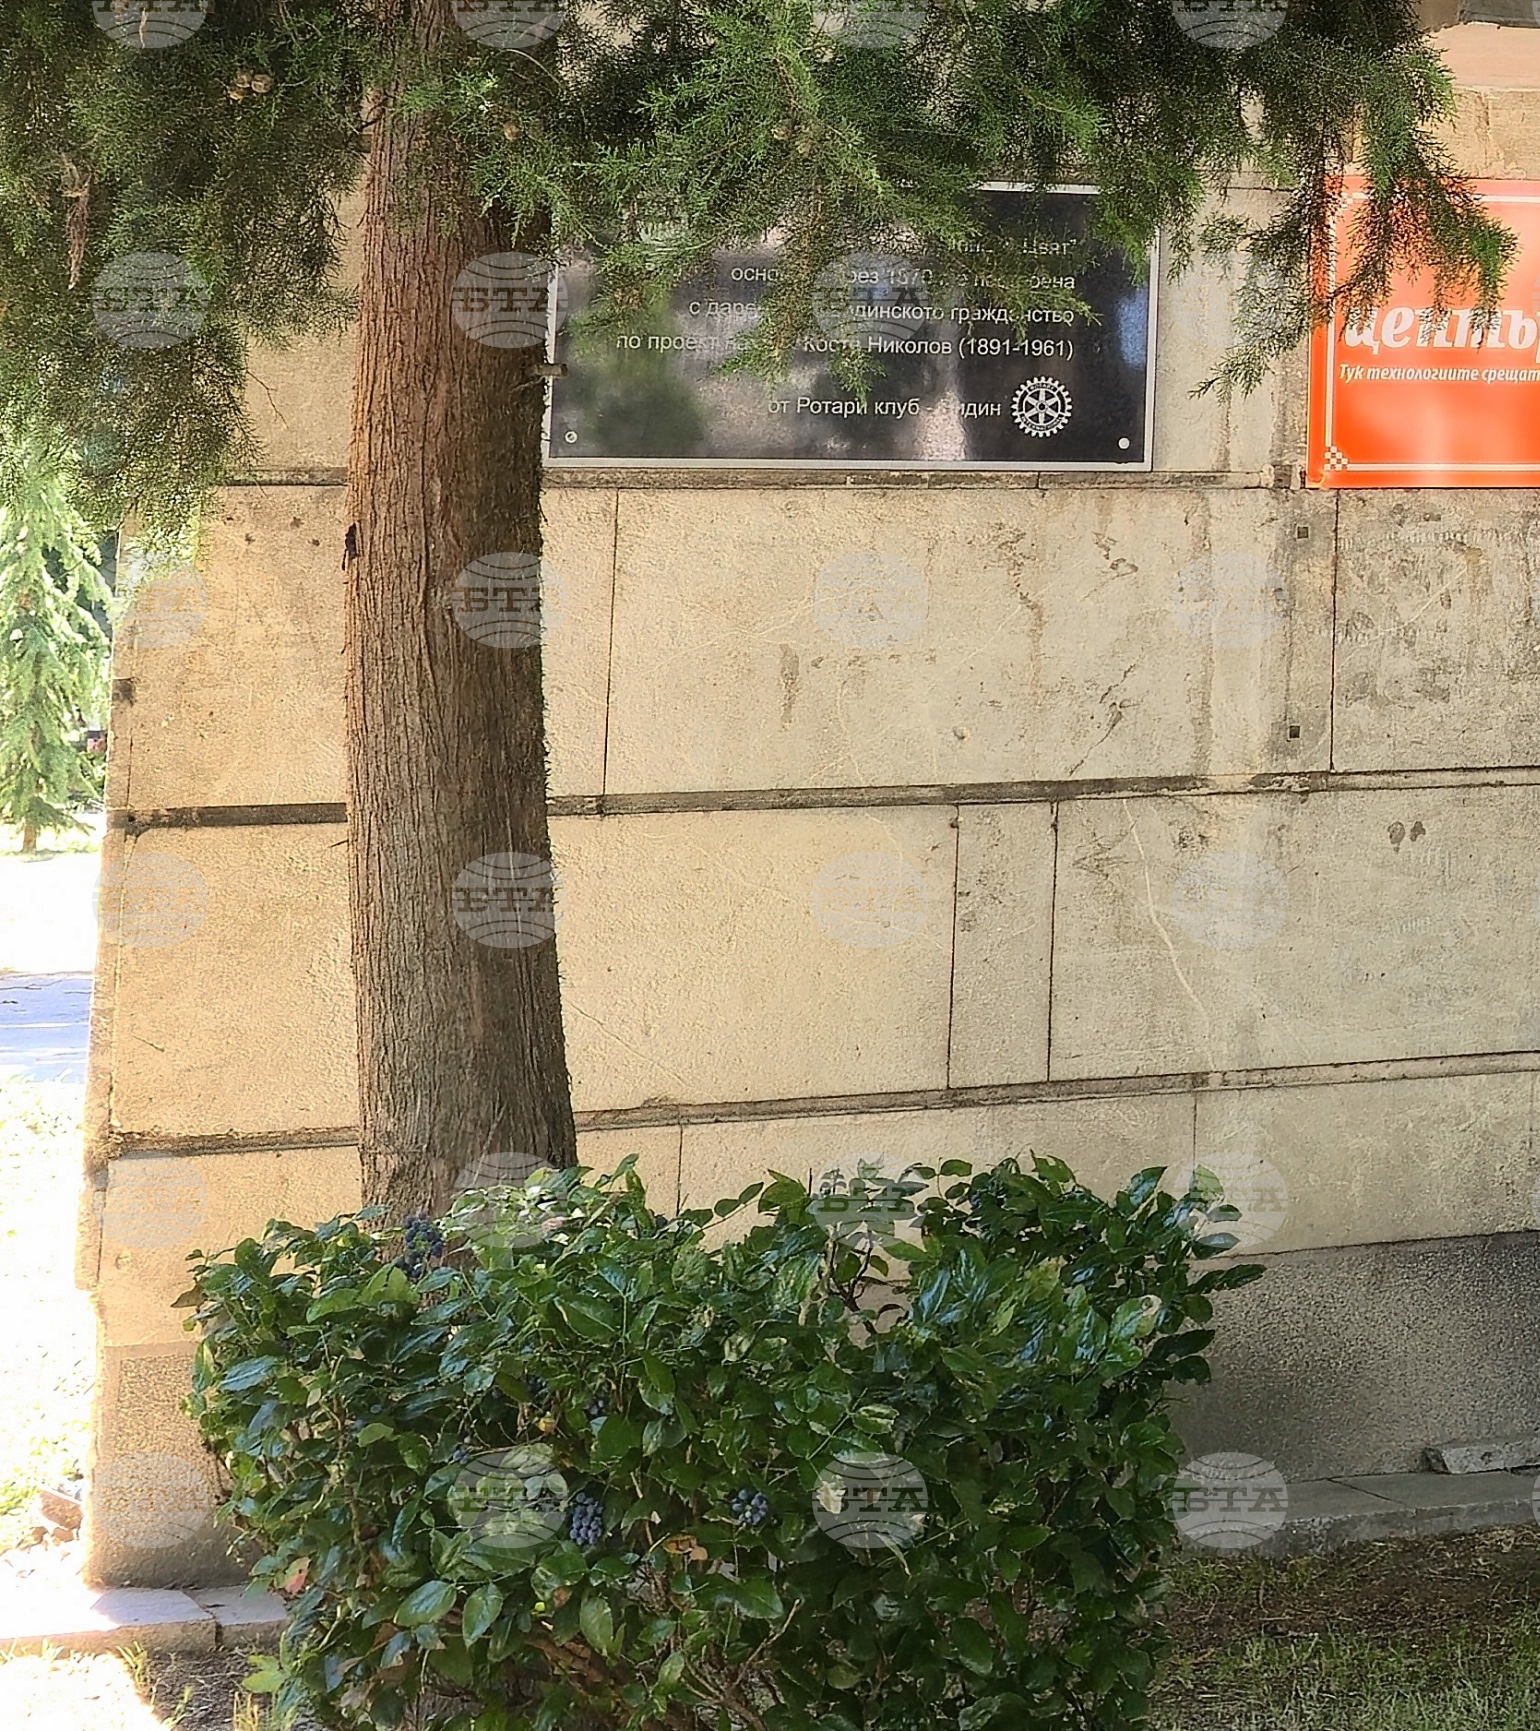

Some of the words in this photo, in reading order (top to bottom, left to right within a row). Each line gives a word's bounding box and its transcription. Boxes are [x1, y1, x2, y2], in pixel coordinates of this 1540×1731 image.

[868, 336, 952, 354] Николов
[958, 337, 1074, 360] (1891-1961)
[1339, 363, 1364, 383] Тук
[1366, 367, 1479, 382] технологиите
[1481, 367, 1540, 383] срещат
[768, 399, 790, 414] от
[796, 396, 868, 418] Ротари
[874, 397, 920, 419] клуб
